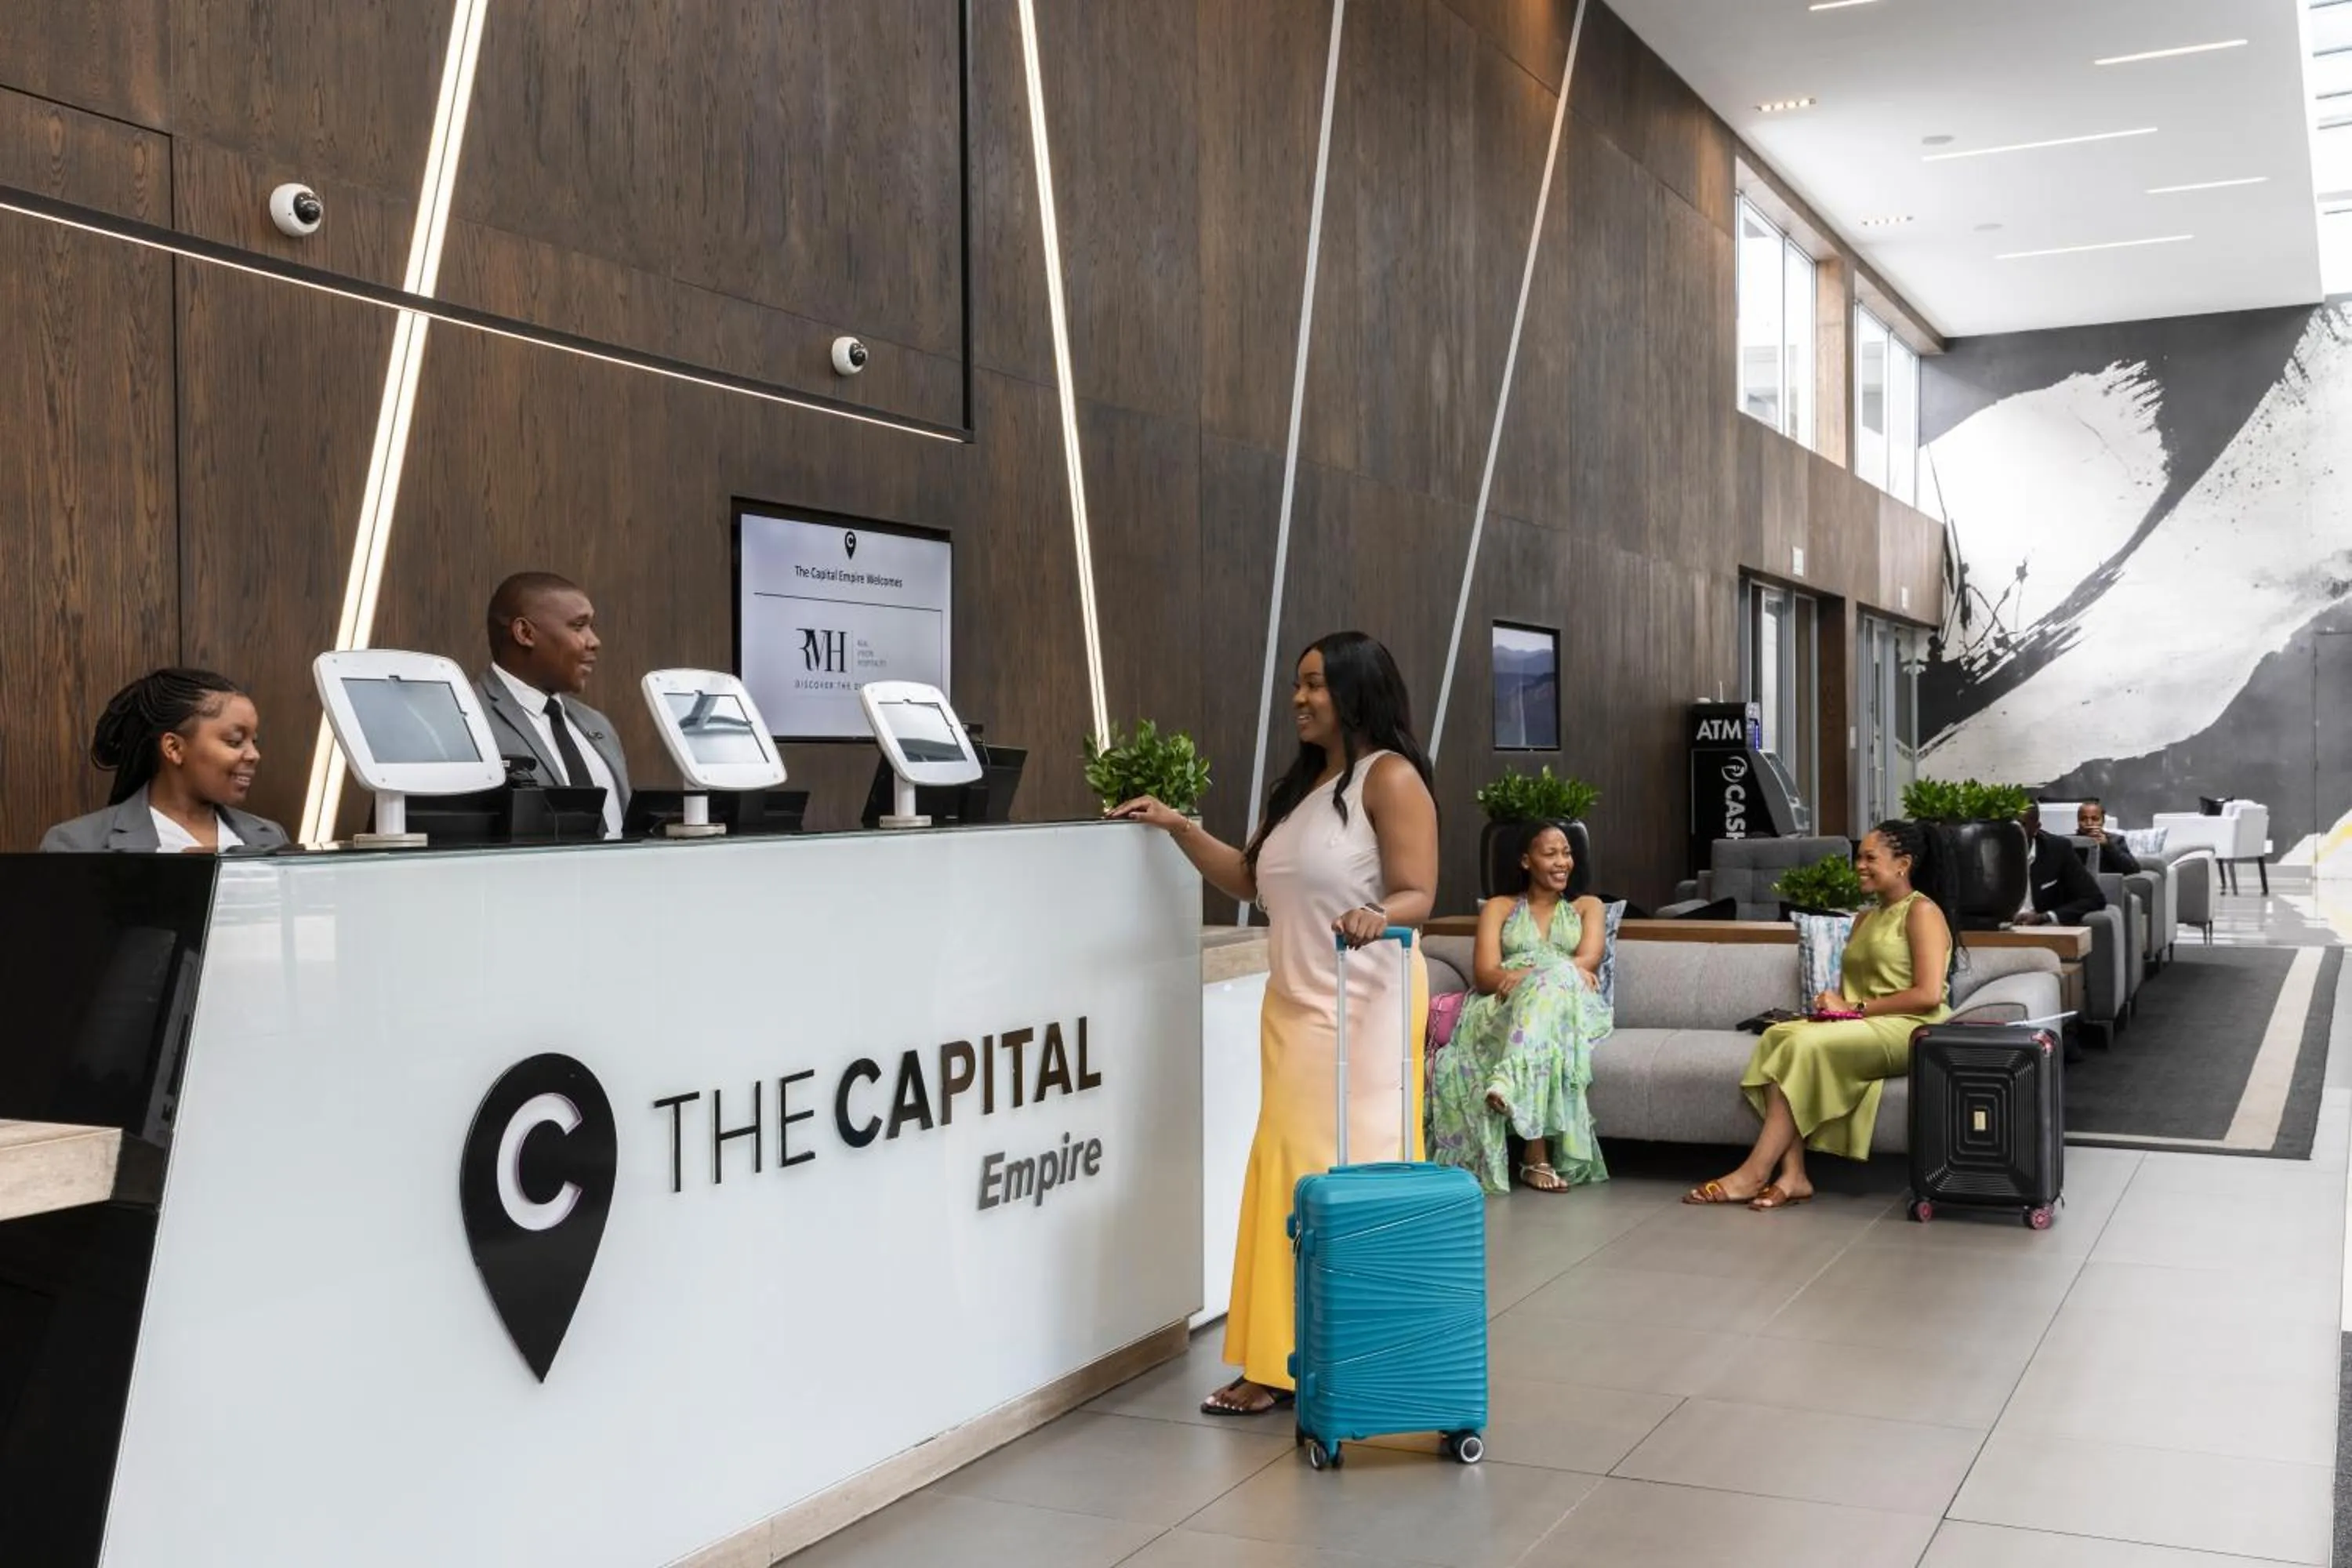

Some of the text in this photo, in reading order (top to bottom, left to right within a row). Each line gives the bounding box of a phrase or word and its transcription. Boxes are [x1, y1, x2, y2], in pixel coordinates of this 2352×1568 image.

[795, 565, 903, 588] The Capital Empire Welcomes
[1696, 719, 1742, 740] ATM
[653, 1016, 1102, 1192] THE CAPITAL
[977, 1132, 1102, 1210] Empire
